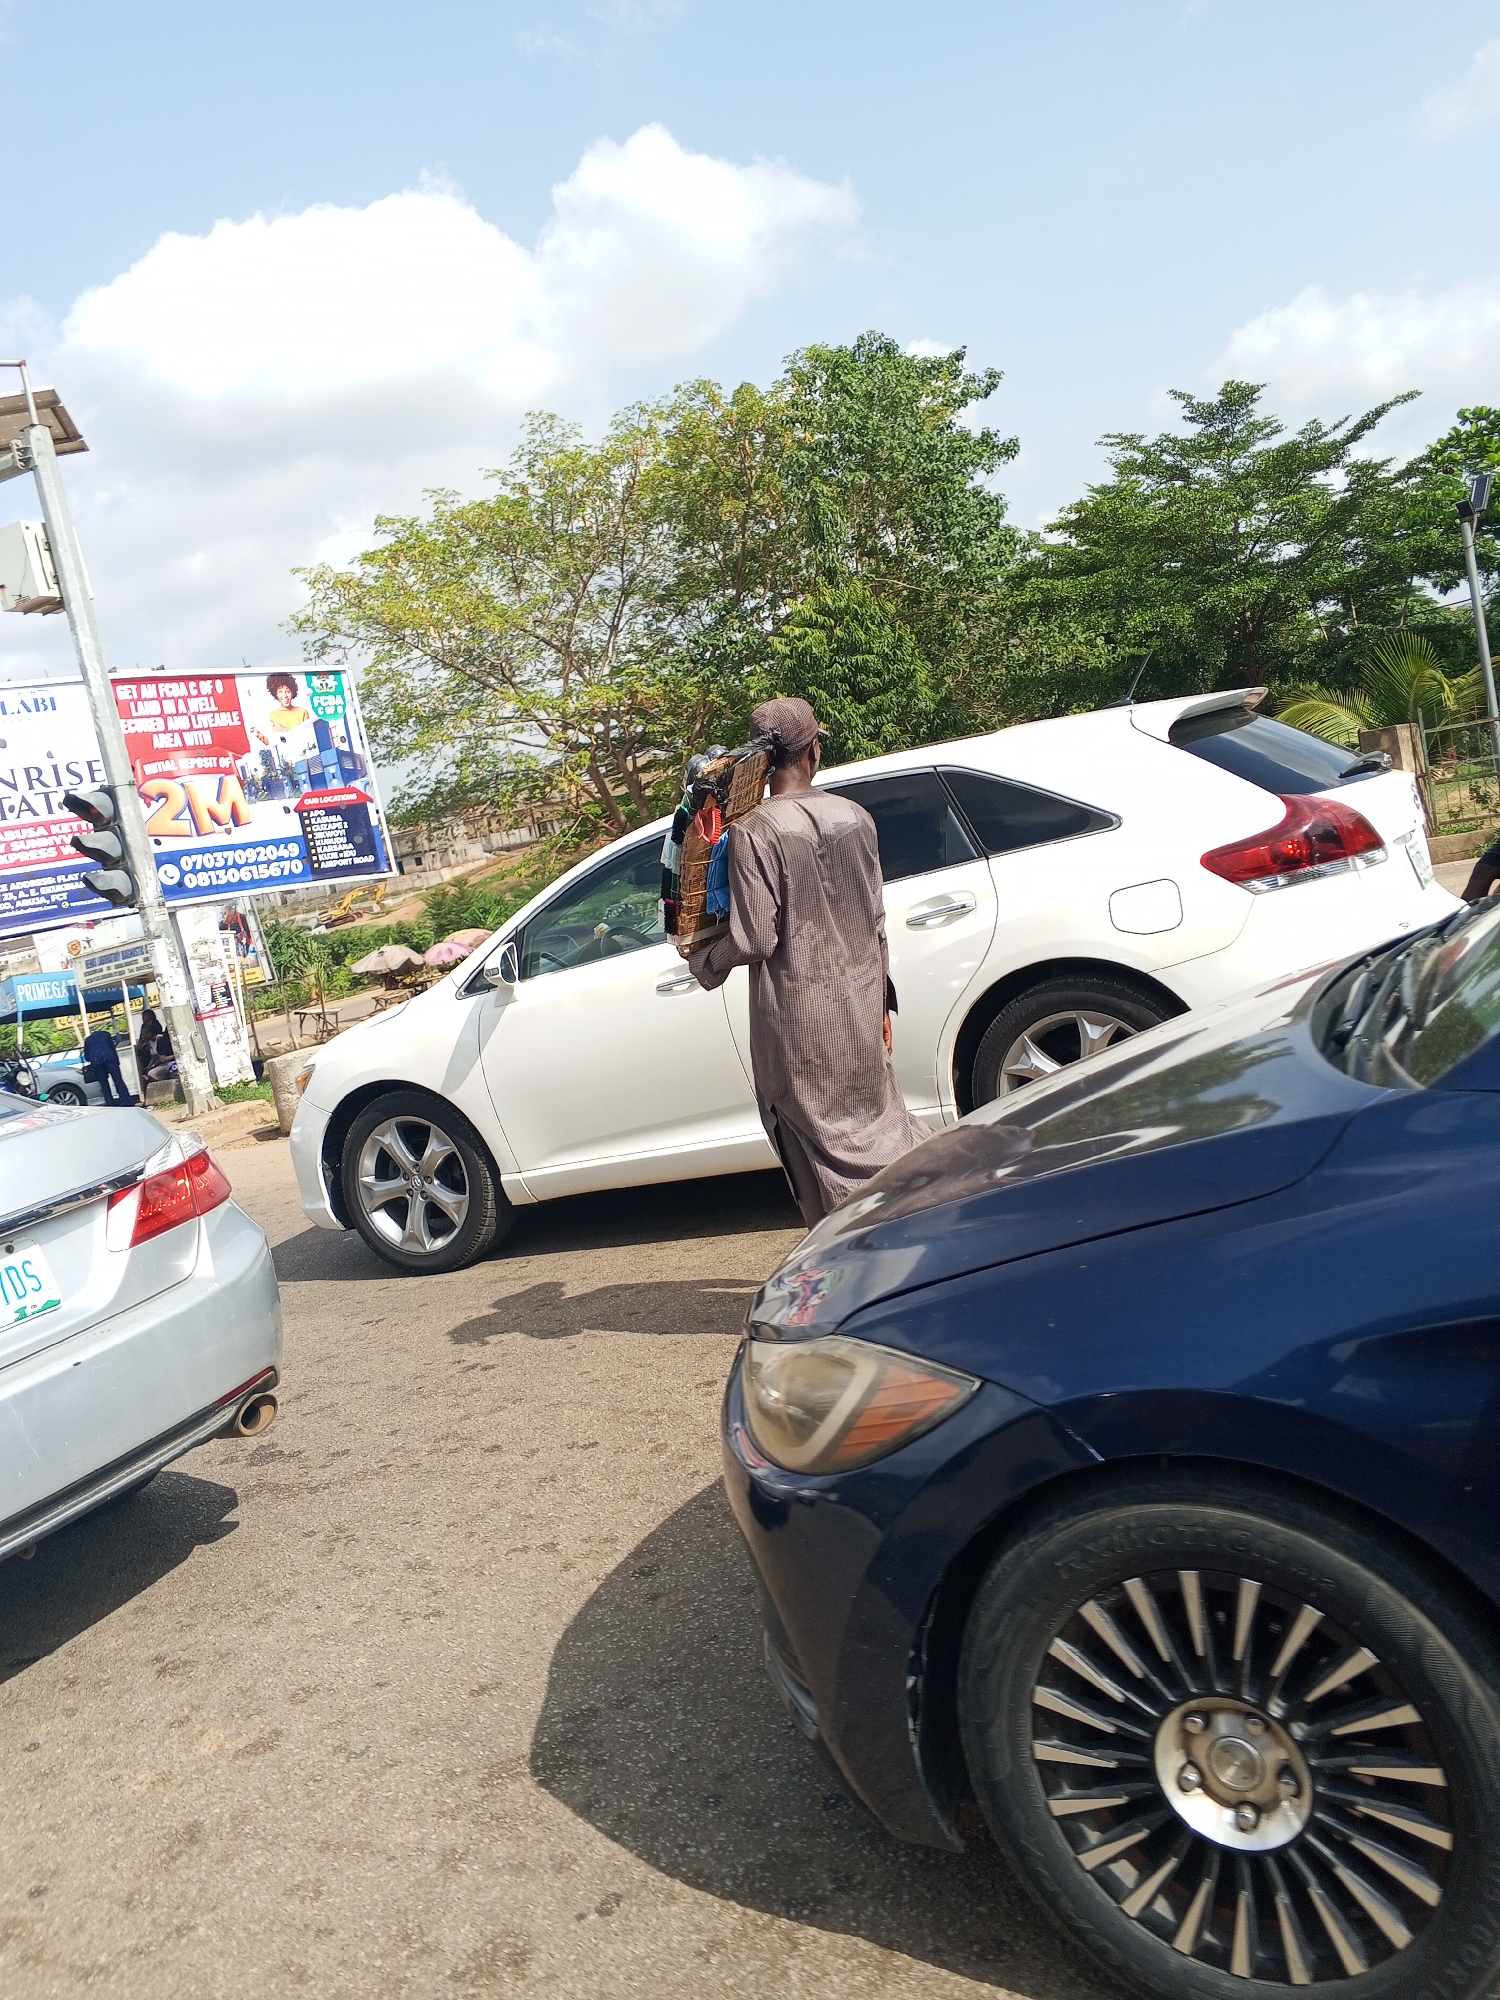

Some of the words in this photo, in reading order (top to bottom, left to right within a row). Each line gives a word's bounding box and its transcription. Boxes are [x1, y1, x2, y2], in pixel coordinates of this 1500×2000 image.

[116, 684, 138, 700] GET
[140, 684, 157, 699] AN
[158, 682, 188, 698] FCDA
[189, 681, 198, 696] C
[199, 680, 213, 695] OF
[130, 700, 161, 717] LAND
[162, 699, 176, 715] IN
[177, 698, 187, 714] A
[187, 696, 219, 713] WELL
[313, 694, 344, 707] FCDA
[119, 717, 165, 734] ECURED
[166, 715, 190, 731] AND
[191, 711, 241, 729] LIVEABLE
[152, 732, 183, 749] AREA
[182, 730, 213, 746] WITH
[143, 759, 178, 776] INITIAL
[178, 757, 218, 774] DEPOSIT
[219, 757, 232, 769] OF
[139, 775, 252, 837] 2M
[304, 797, 319, 805] OUR
[320, 793, 357, 804] LOCATIONS
[180, 843, 300, 871] 07037092049
[320, 858, 352, 869] AIRPORT
[353, 855, 375, 864] ROAD
[57, 872, 79, 883] FLAT
[184, 859, 303, 888] 08130615670
[51, 892, 68, 902] FCT
[16, 977, 77, 1002] PRIMEGAT
